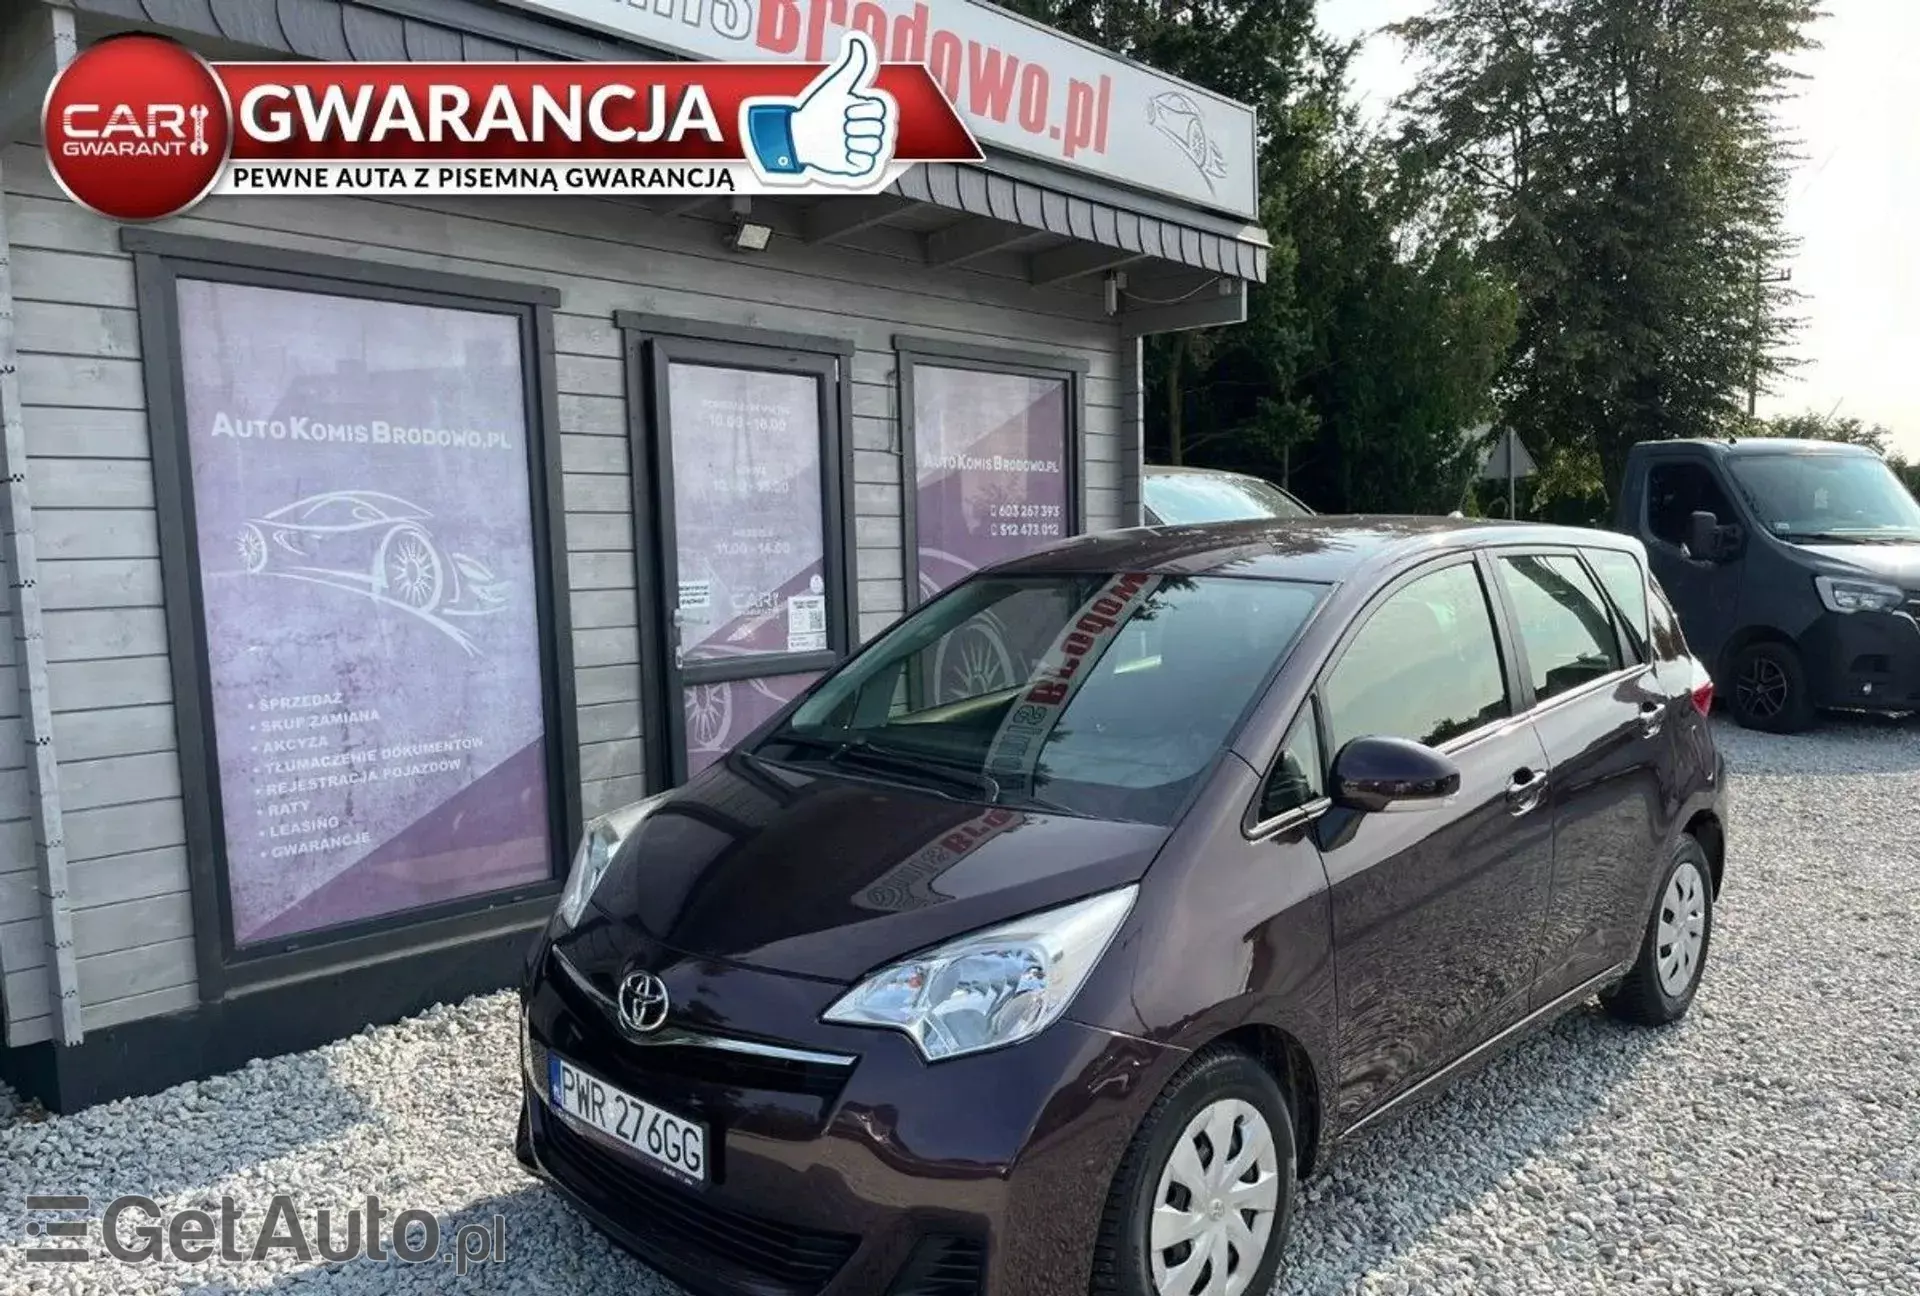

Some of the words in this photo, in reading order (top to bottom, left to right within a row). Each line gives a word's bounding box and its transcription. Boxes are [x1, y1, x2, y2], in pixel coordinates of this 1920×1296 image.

[1000, 504, 1020, 517] 603
[999, 523, 1019, 536] 512
[1020, 524, 1040, 536] 473
[309, 708, 380, 728] ZAMIANA
[263, 735, 328, 754] AKCYZA
[266, 771, 378, 796] REJESTRACJA
[268, 800, 312, 818] RATY
[271, 832, 371, 859] GWARANCJE
[562, 1066, 606, 1128] PWR
[615, 1095, 701, 1172] 276GG
